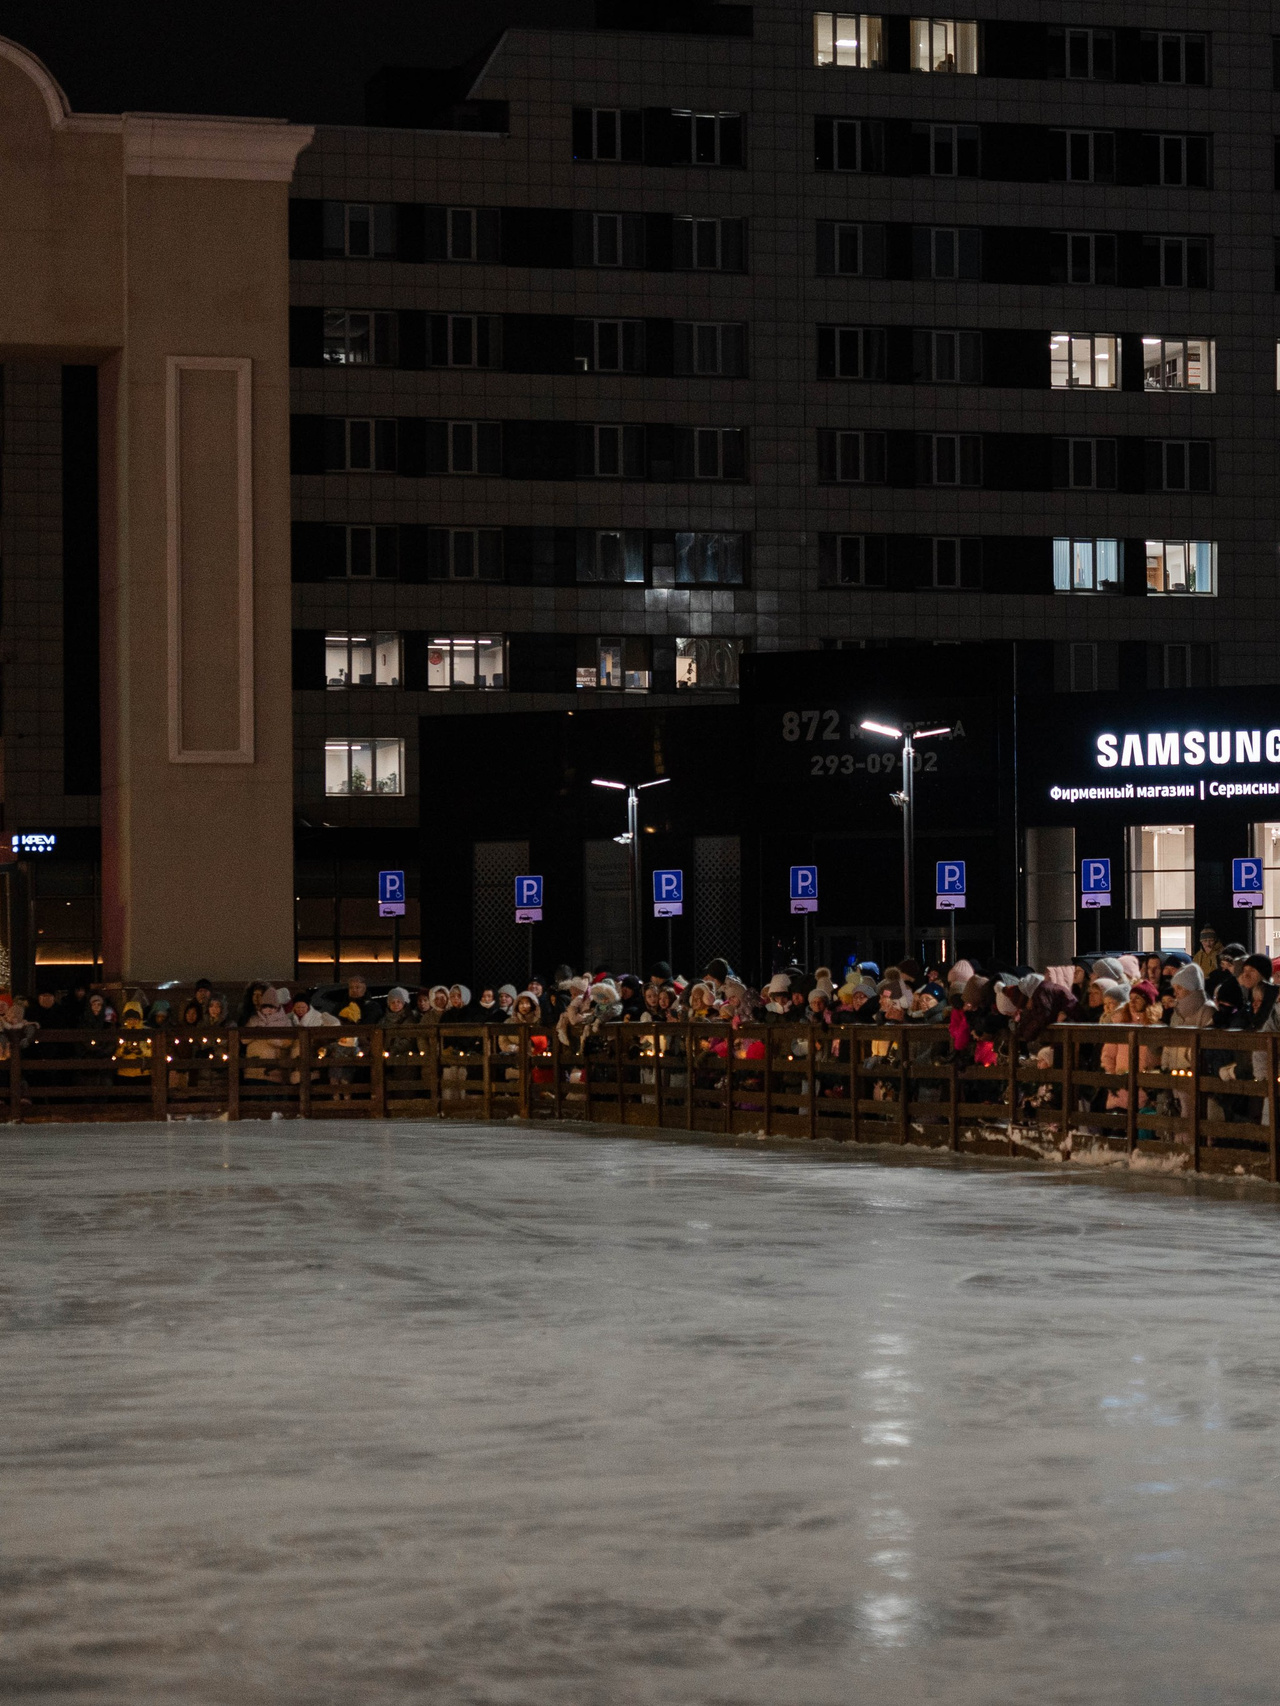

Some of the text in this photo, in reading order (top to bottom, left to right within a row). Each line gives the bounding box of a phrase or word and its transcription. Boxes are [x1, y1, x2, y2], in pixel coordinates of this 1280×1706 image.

[781, 709, 840, 742] 872
[1049, 783, 1134, 803] Фирменный
[1136, 784, 1195, 799] магазин
